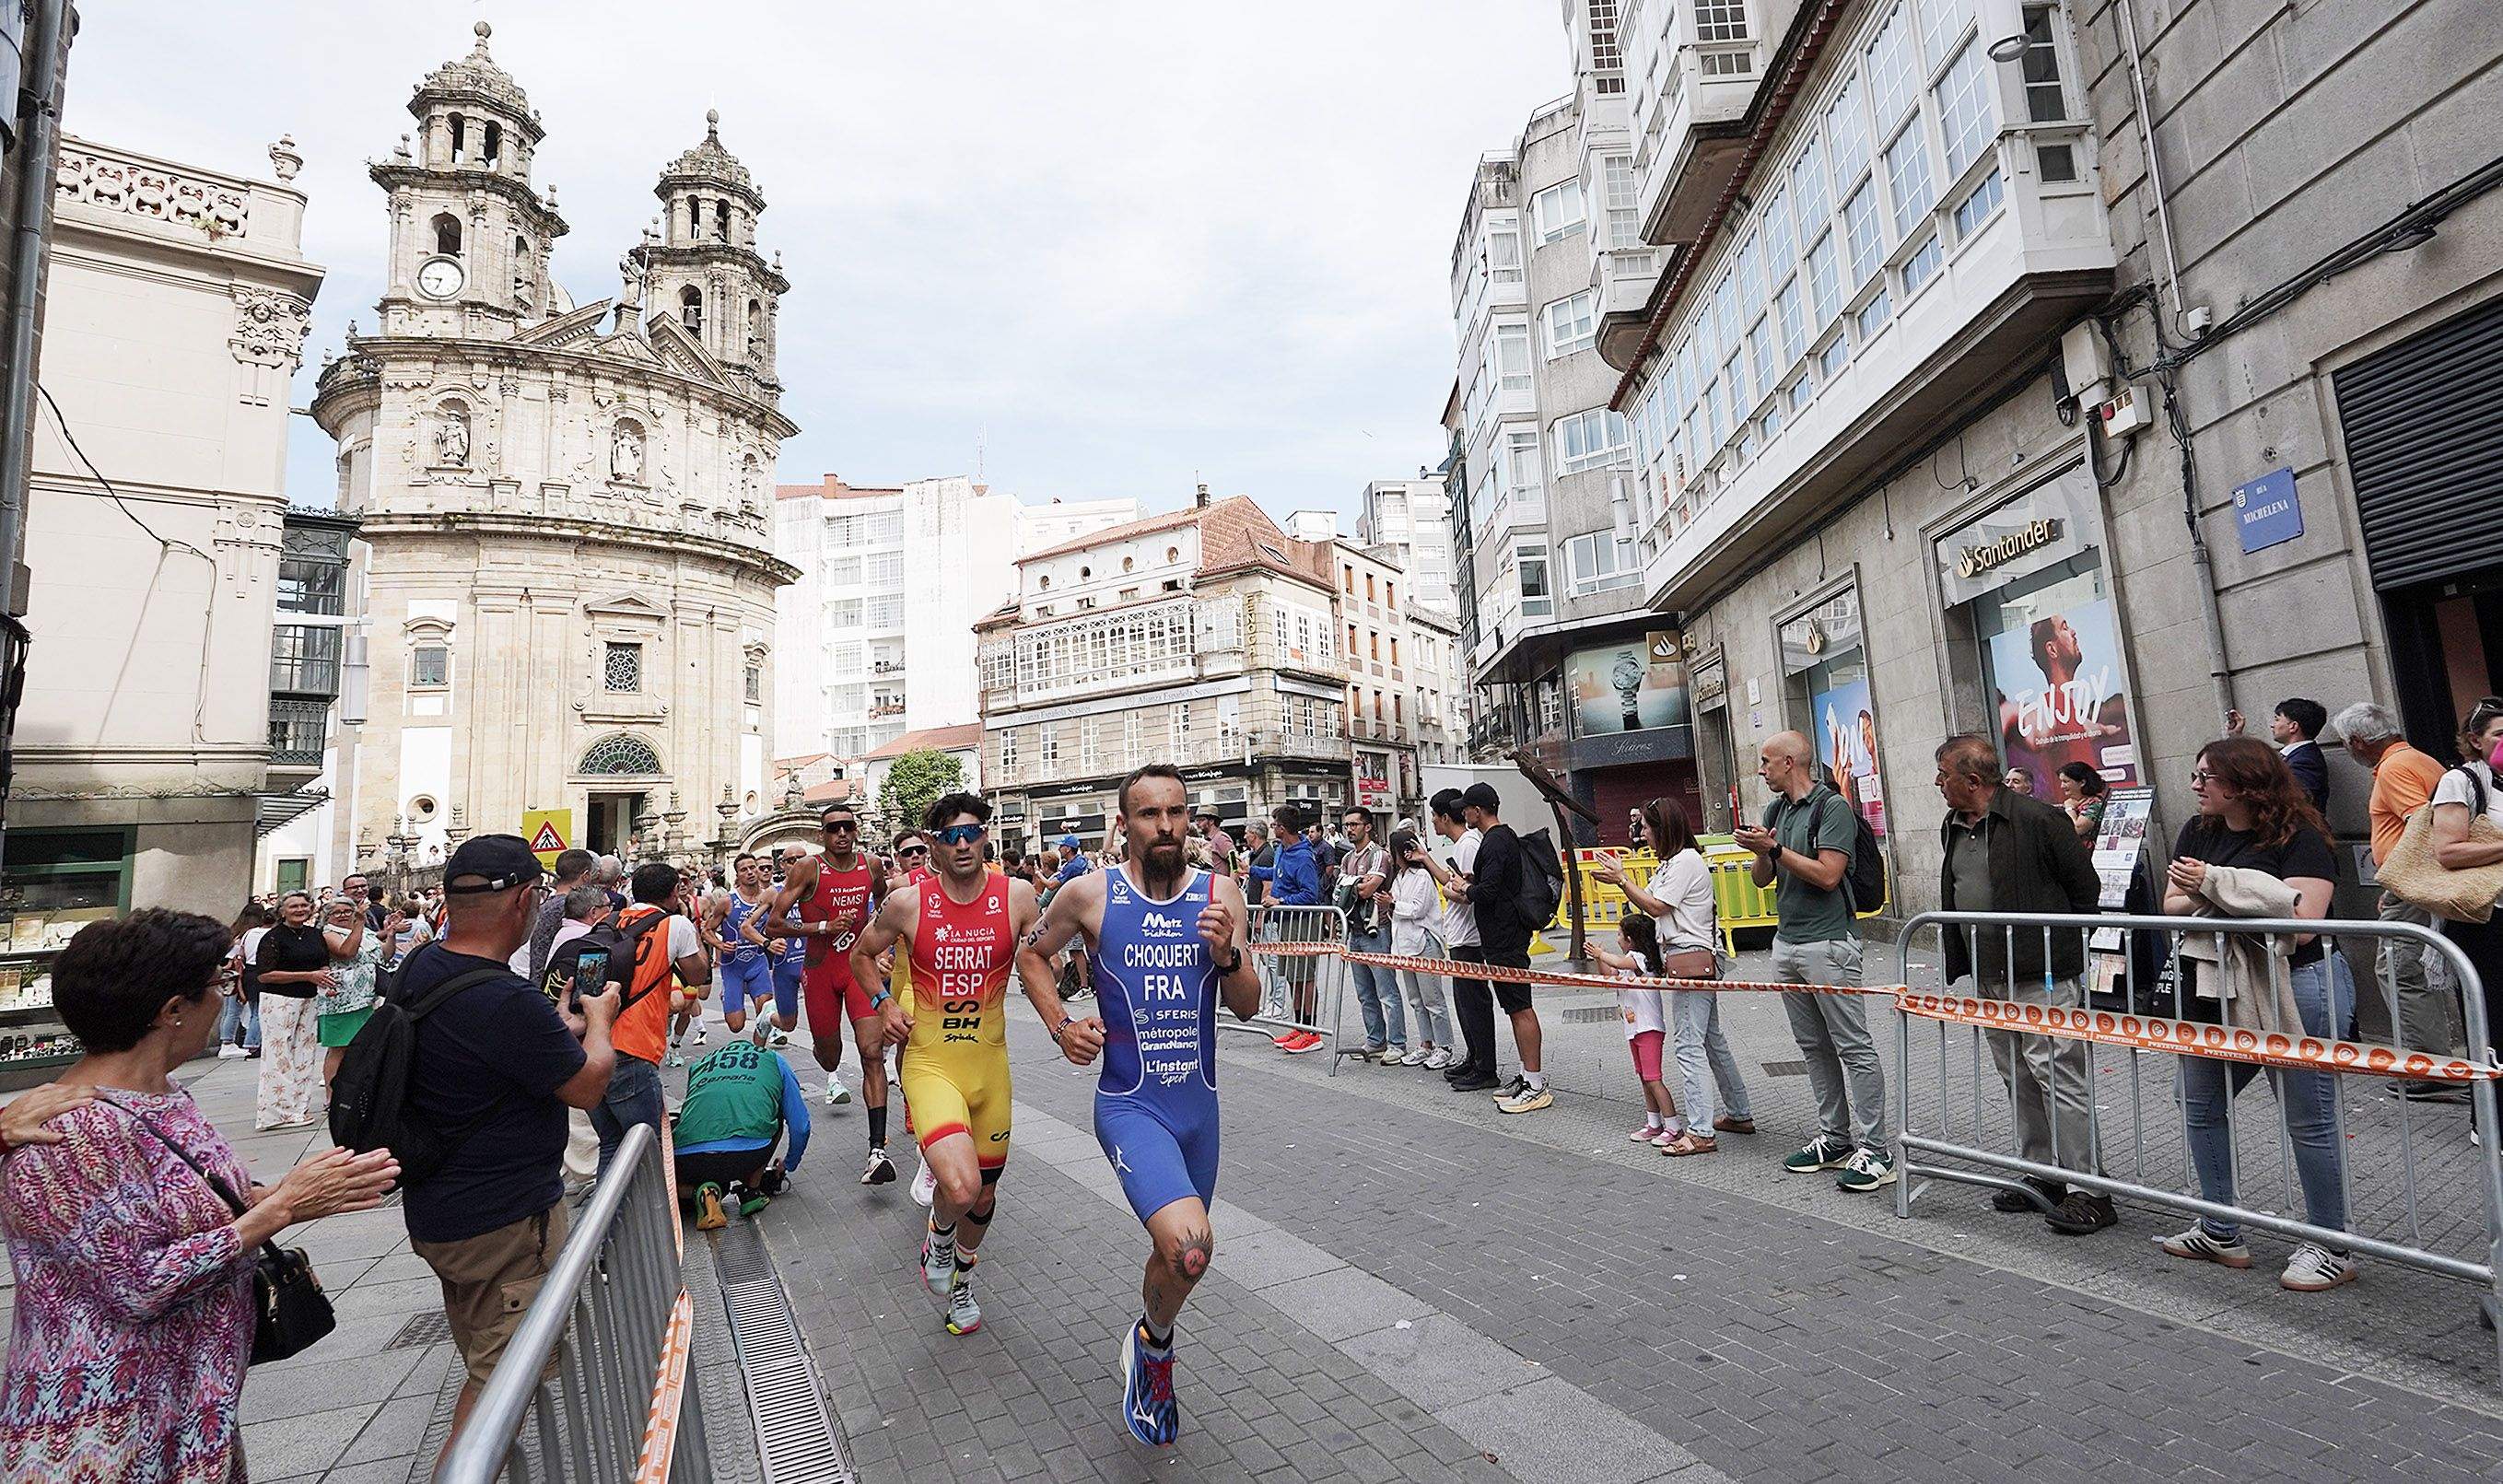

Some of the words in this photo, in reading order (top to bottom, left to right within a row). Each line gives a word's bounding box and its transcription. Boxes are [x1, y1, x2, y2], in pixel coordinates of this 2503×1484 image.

[2243, 499, 2288, 525] MICHELENA
[1974, 519, 2050, 572] Santander
[2015, 665, 2109, 738] ENJOY
[832, 894, 864, 906] NEMSI
[1141, 912, 1182, 929] Metz
[1141, 929, 1183, 938] Triathlon
[934, 945, 993, 970] SERRAT
[1124, 943, 1200, 968] CHOQUERT
[942, 972, 983, 998] ESP
[1143, 975, 1187, 1001] FRA
[942, 1017, 981, 1030] BH
[1156, 1010, 1198, 1021] SFERIS
[1139, 1026, 1199, 1041] métropole
[708, 1052, 759, 1072] 458
[1146, 1060, 1199, 1074] L'instant
[1159, 1071, 1190, 1088] Sport
